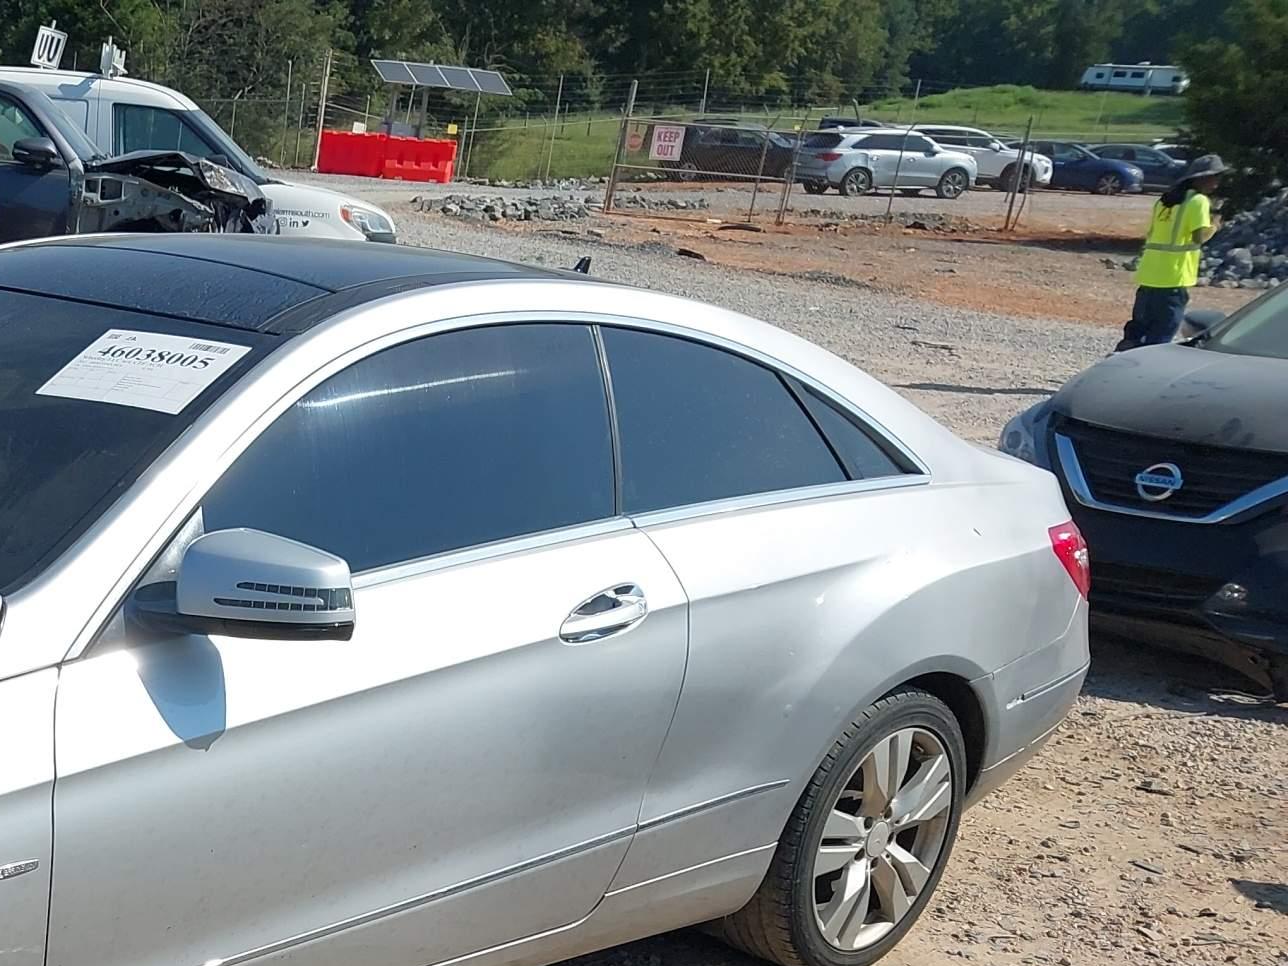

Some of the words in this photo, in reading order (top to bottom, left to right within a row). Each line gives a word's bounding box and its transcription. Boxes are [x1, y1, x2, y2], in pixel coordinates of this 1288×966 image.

[657, 131, 680, 142] KEEP
[656, 144, 675, 156] OUT
[98, 344, 215, 370] 46038005
